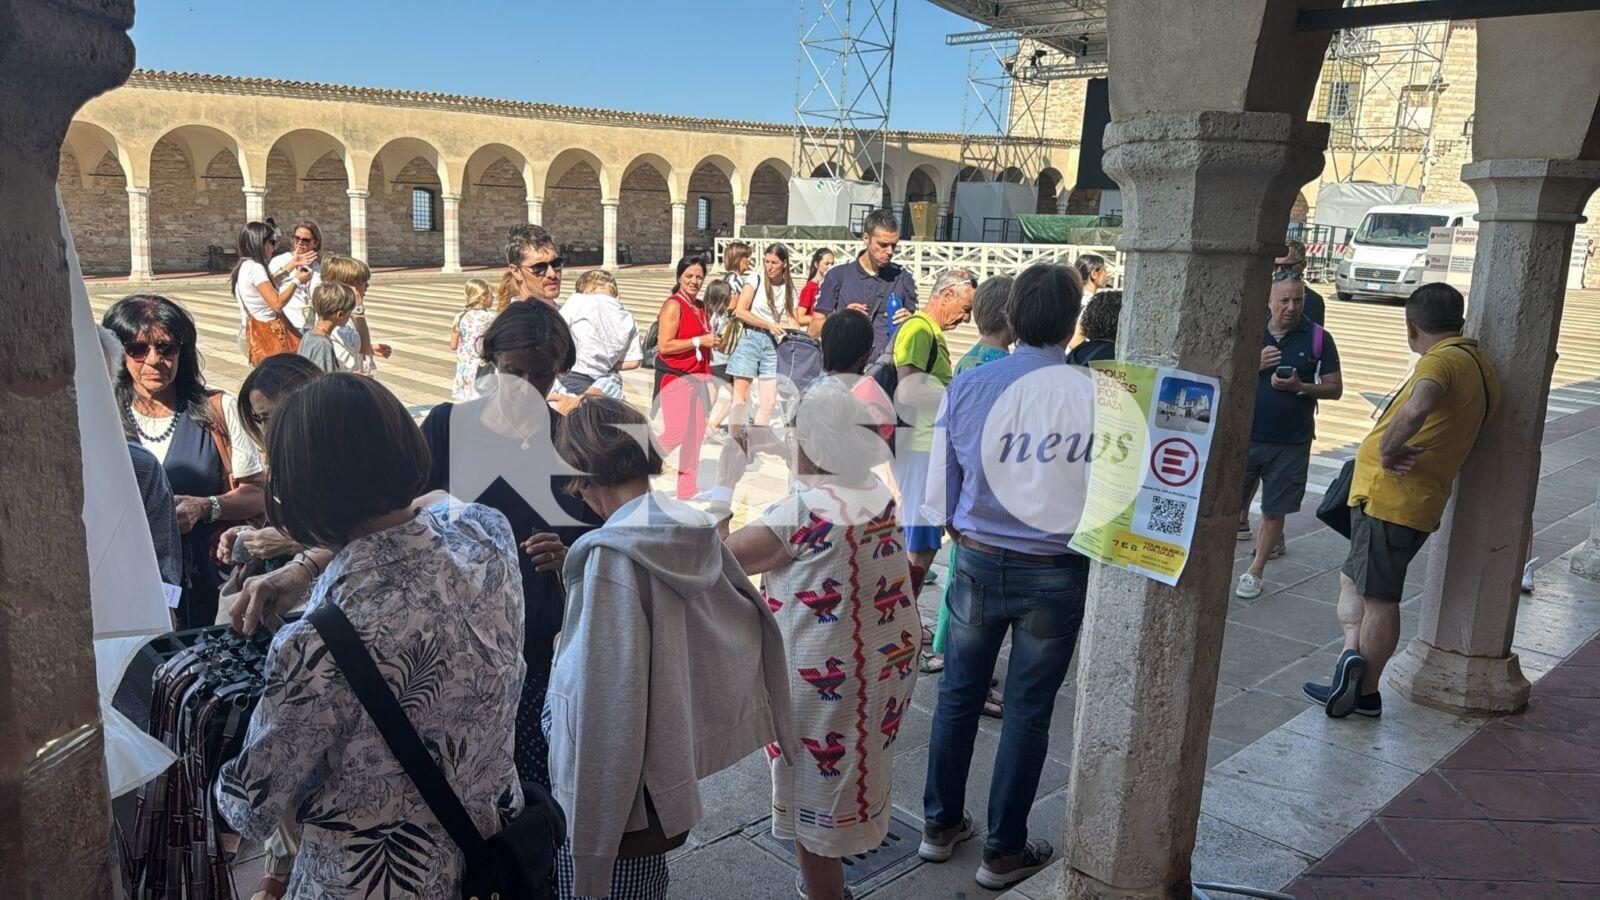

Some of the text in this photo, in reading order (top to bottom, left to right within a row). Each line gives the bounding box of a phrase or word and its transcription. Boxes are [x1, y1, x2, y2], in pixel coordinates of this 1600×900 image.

[1095, 368, 1127, 381] TOUR
[1097, 387, 1118, 400] FOR
[1097, 397, 1124, 412] GAZA
